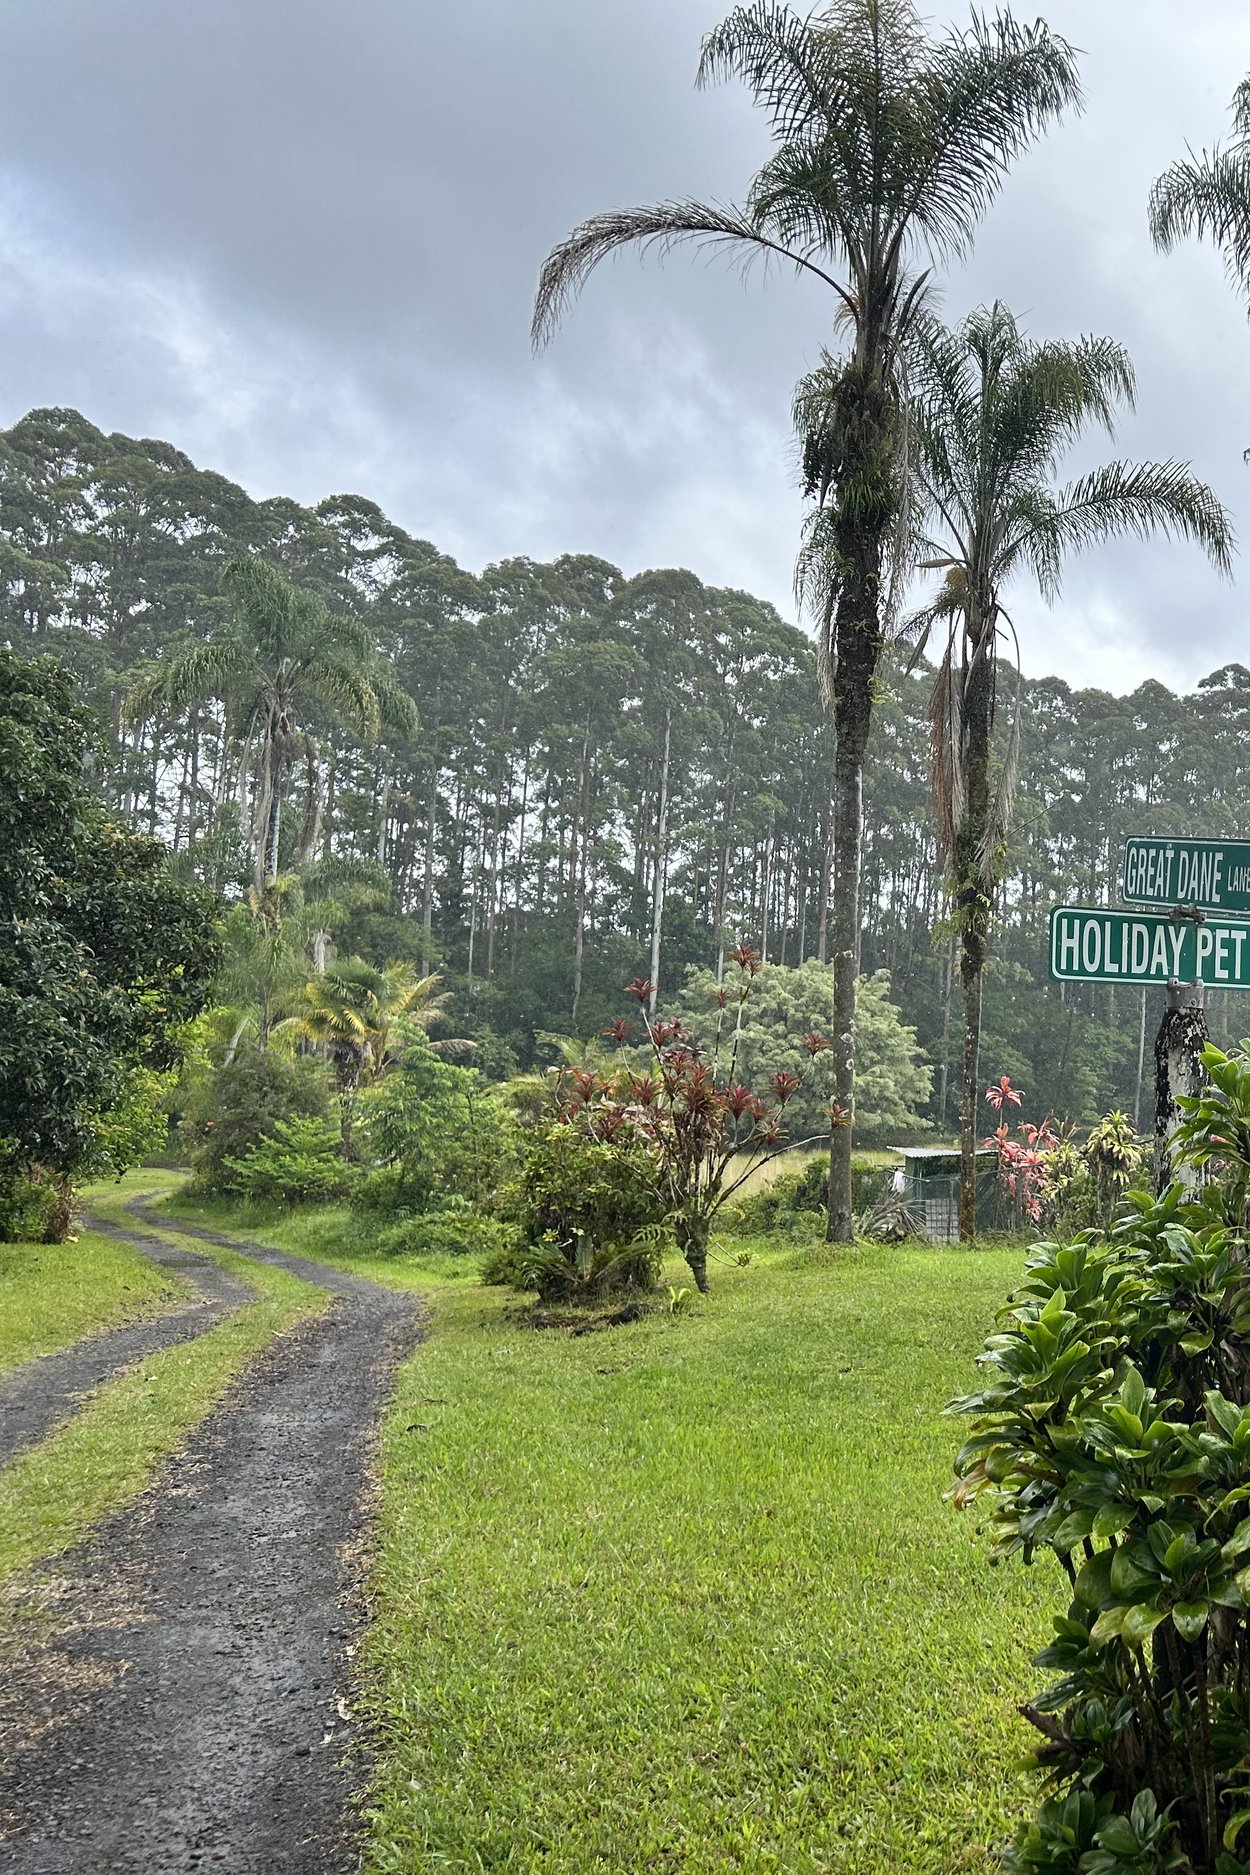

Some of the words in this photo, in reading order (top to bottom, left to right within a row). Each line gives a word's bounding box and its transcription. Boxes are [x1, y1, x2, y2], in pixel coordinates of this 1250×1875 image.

[1127, 846, 1175, 898] GREAT
[1177, 850, 1224, 903] DANE
[1060, 918, 1187, 976] HOLIDAY
[1195, 927, 1247, 980] PET
